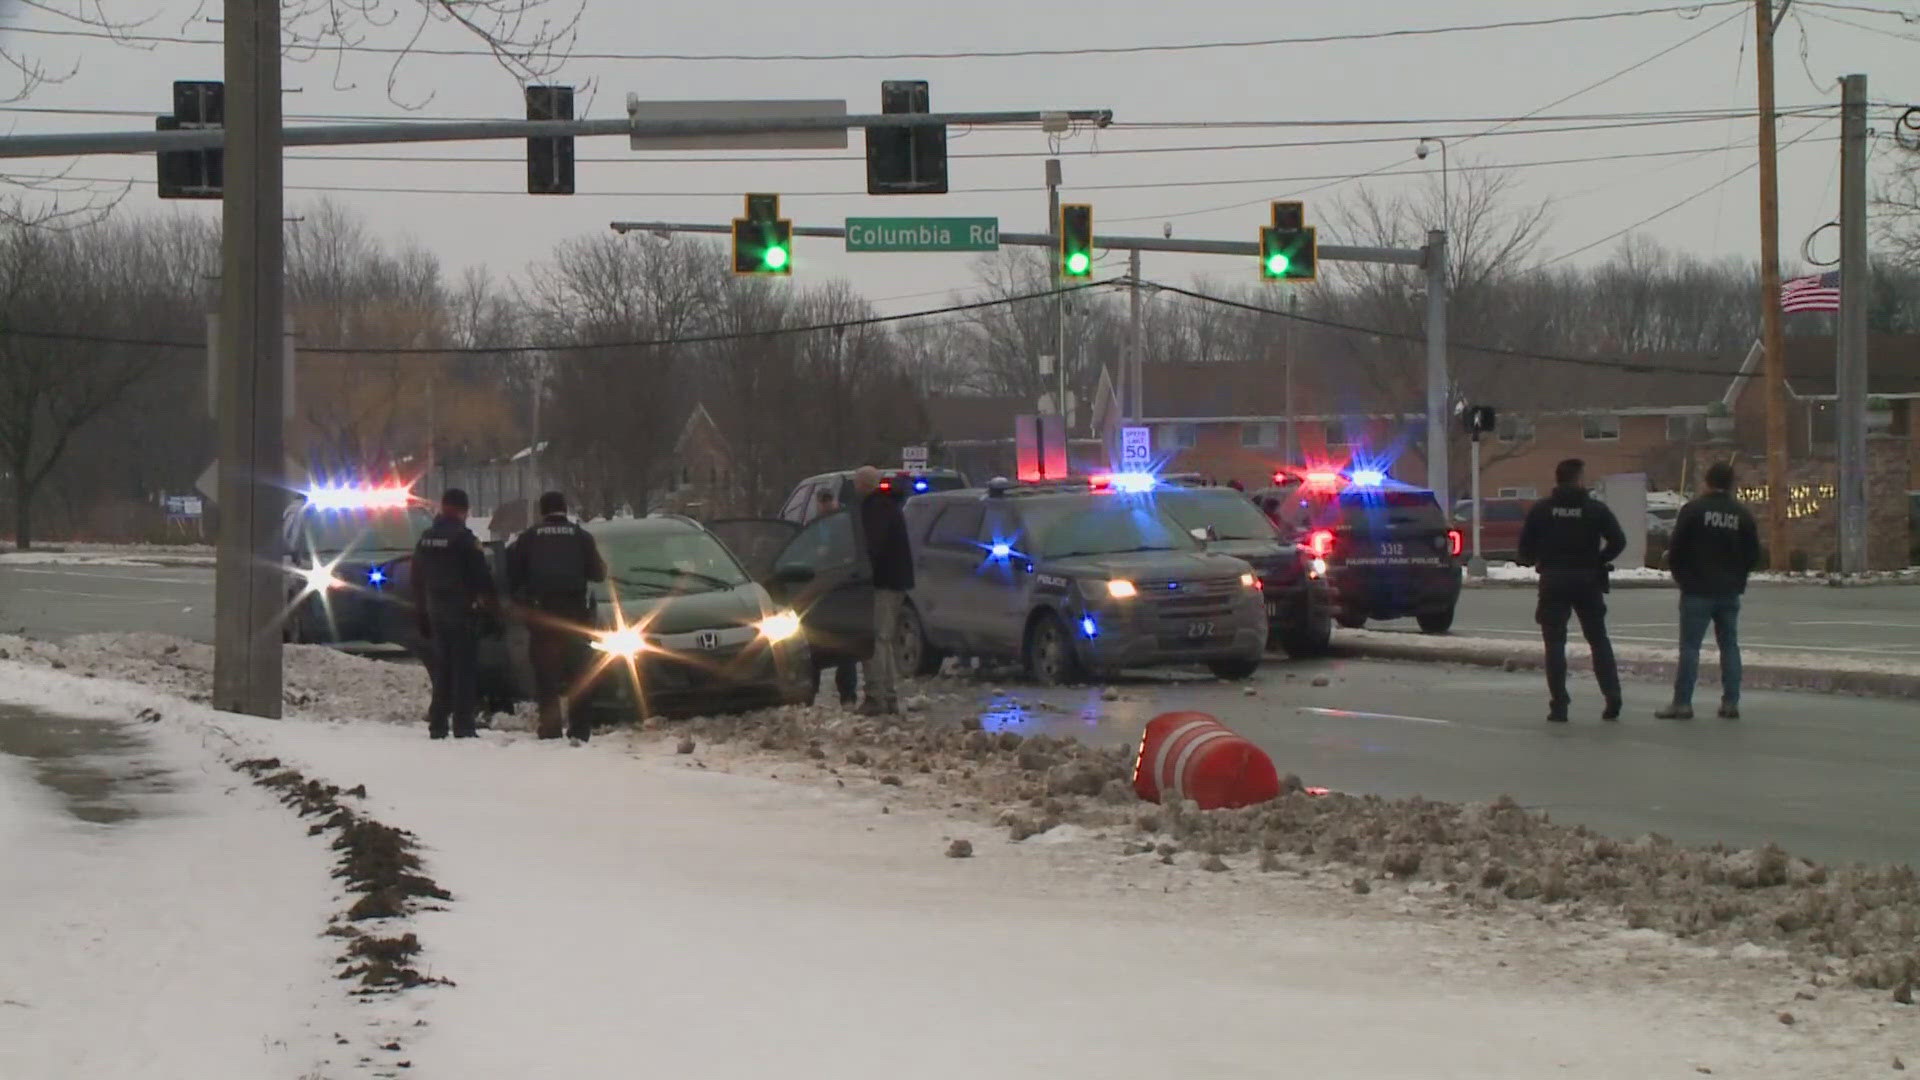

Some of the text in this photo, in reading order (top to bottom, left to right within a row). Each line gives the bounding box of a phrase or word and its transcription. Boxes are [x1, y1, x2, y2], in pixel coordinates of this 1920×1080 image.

[849, 224, 996, 245] Columbia Rd
[1126, 445, 1147, 458] 50
[1552, 507, 1582, 518] POLICE
[1704, 511, 1739, 530] POLICE
[537, 526, 575, 535] POLICE
[1381, 544, 1404, 555] 3312
[1388, 557, 1409, 565] PARK
[1411, 557, 1440, 565] POLICE
[1037, 574, 1067, 587] POLICE
[1187, 622, 1216, 639] 292
